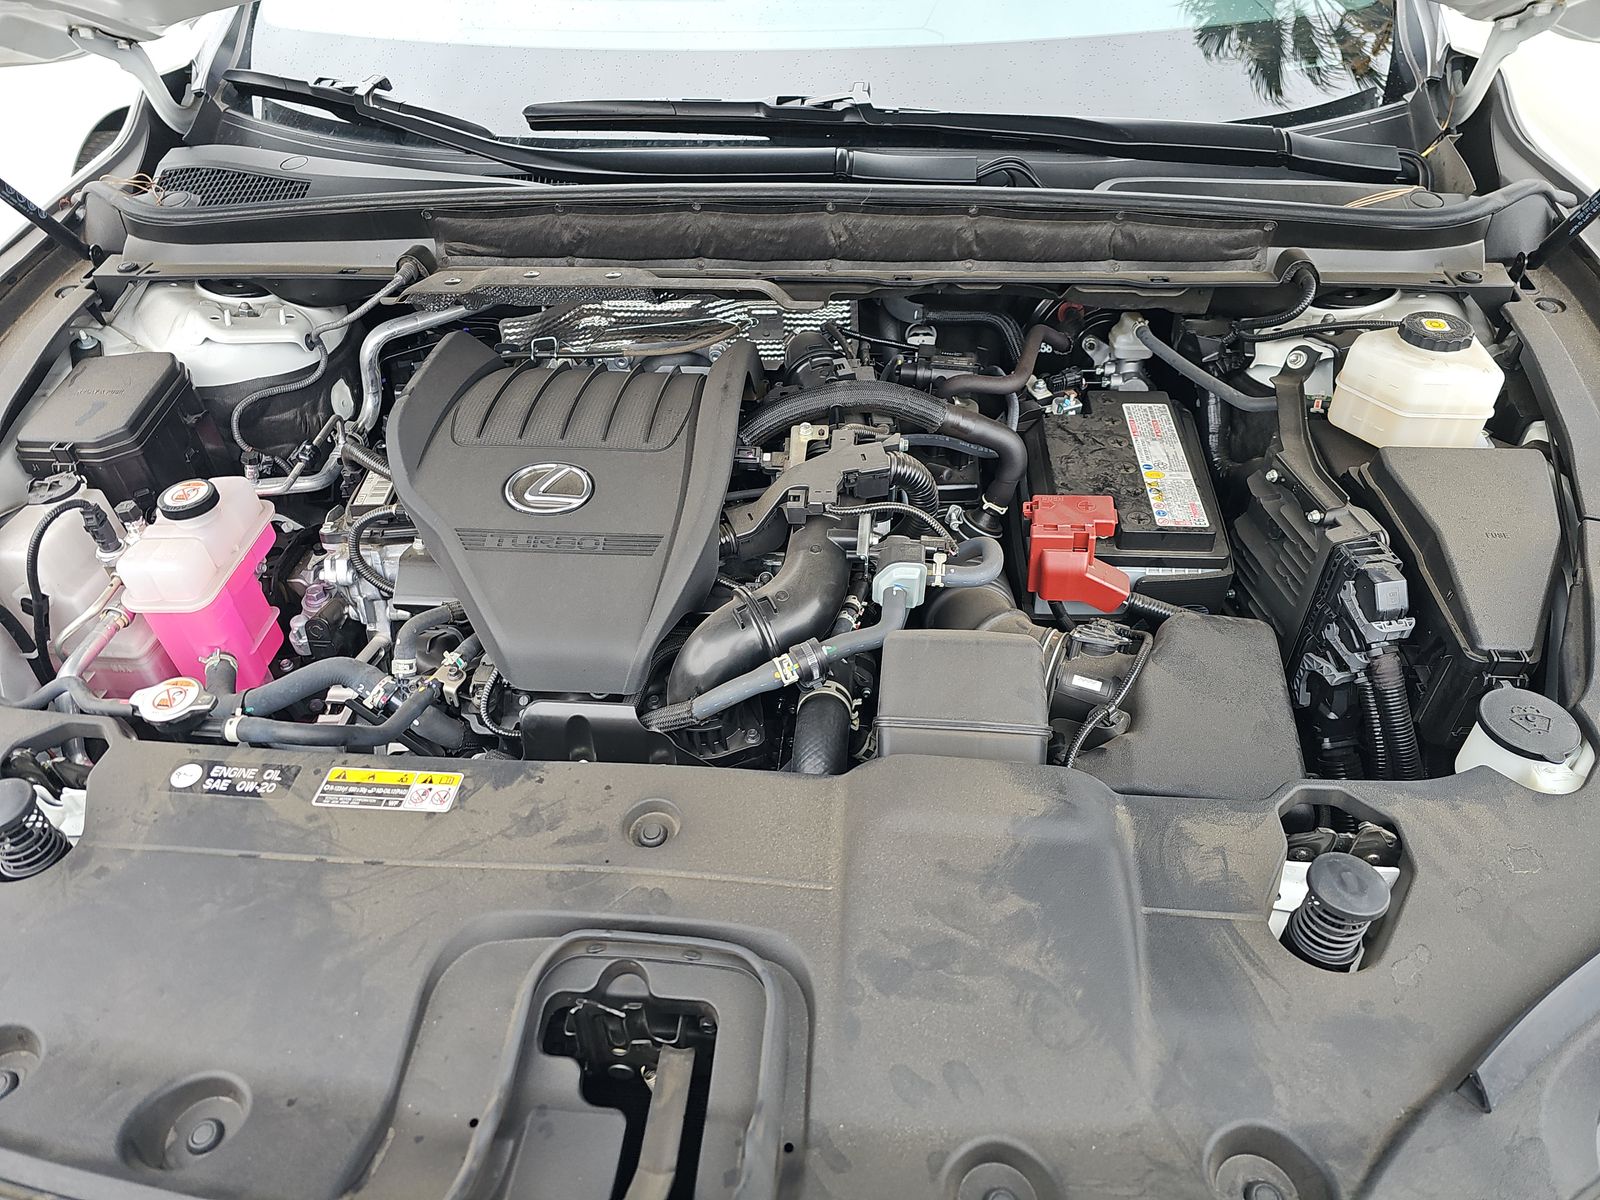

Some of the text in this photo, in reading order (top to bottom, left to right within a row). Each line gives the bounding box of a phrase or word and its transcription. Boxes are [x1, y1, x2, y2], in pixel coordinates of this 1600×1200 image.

[485, 533, 602, 552] TURBO
[210, 766, 282, 781] ENGINE OIL
[202, 778, 277, 793] SAE 0W-20
